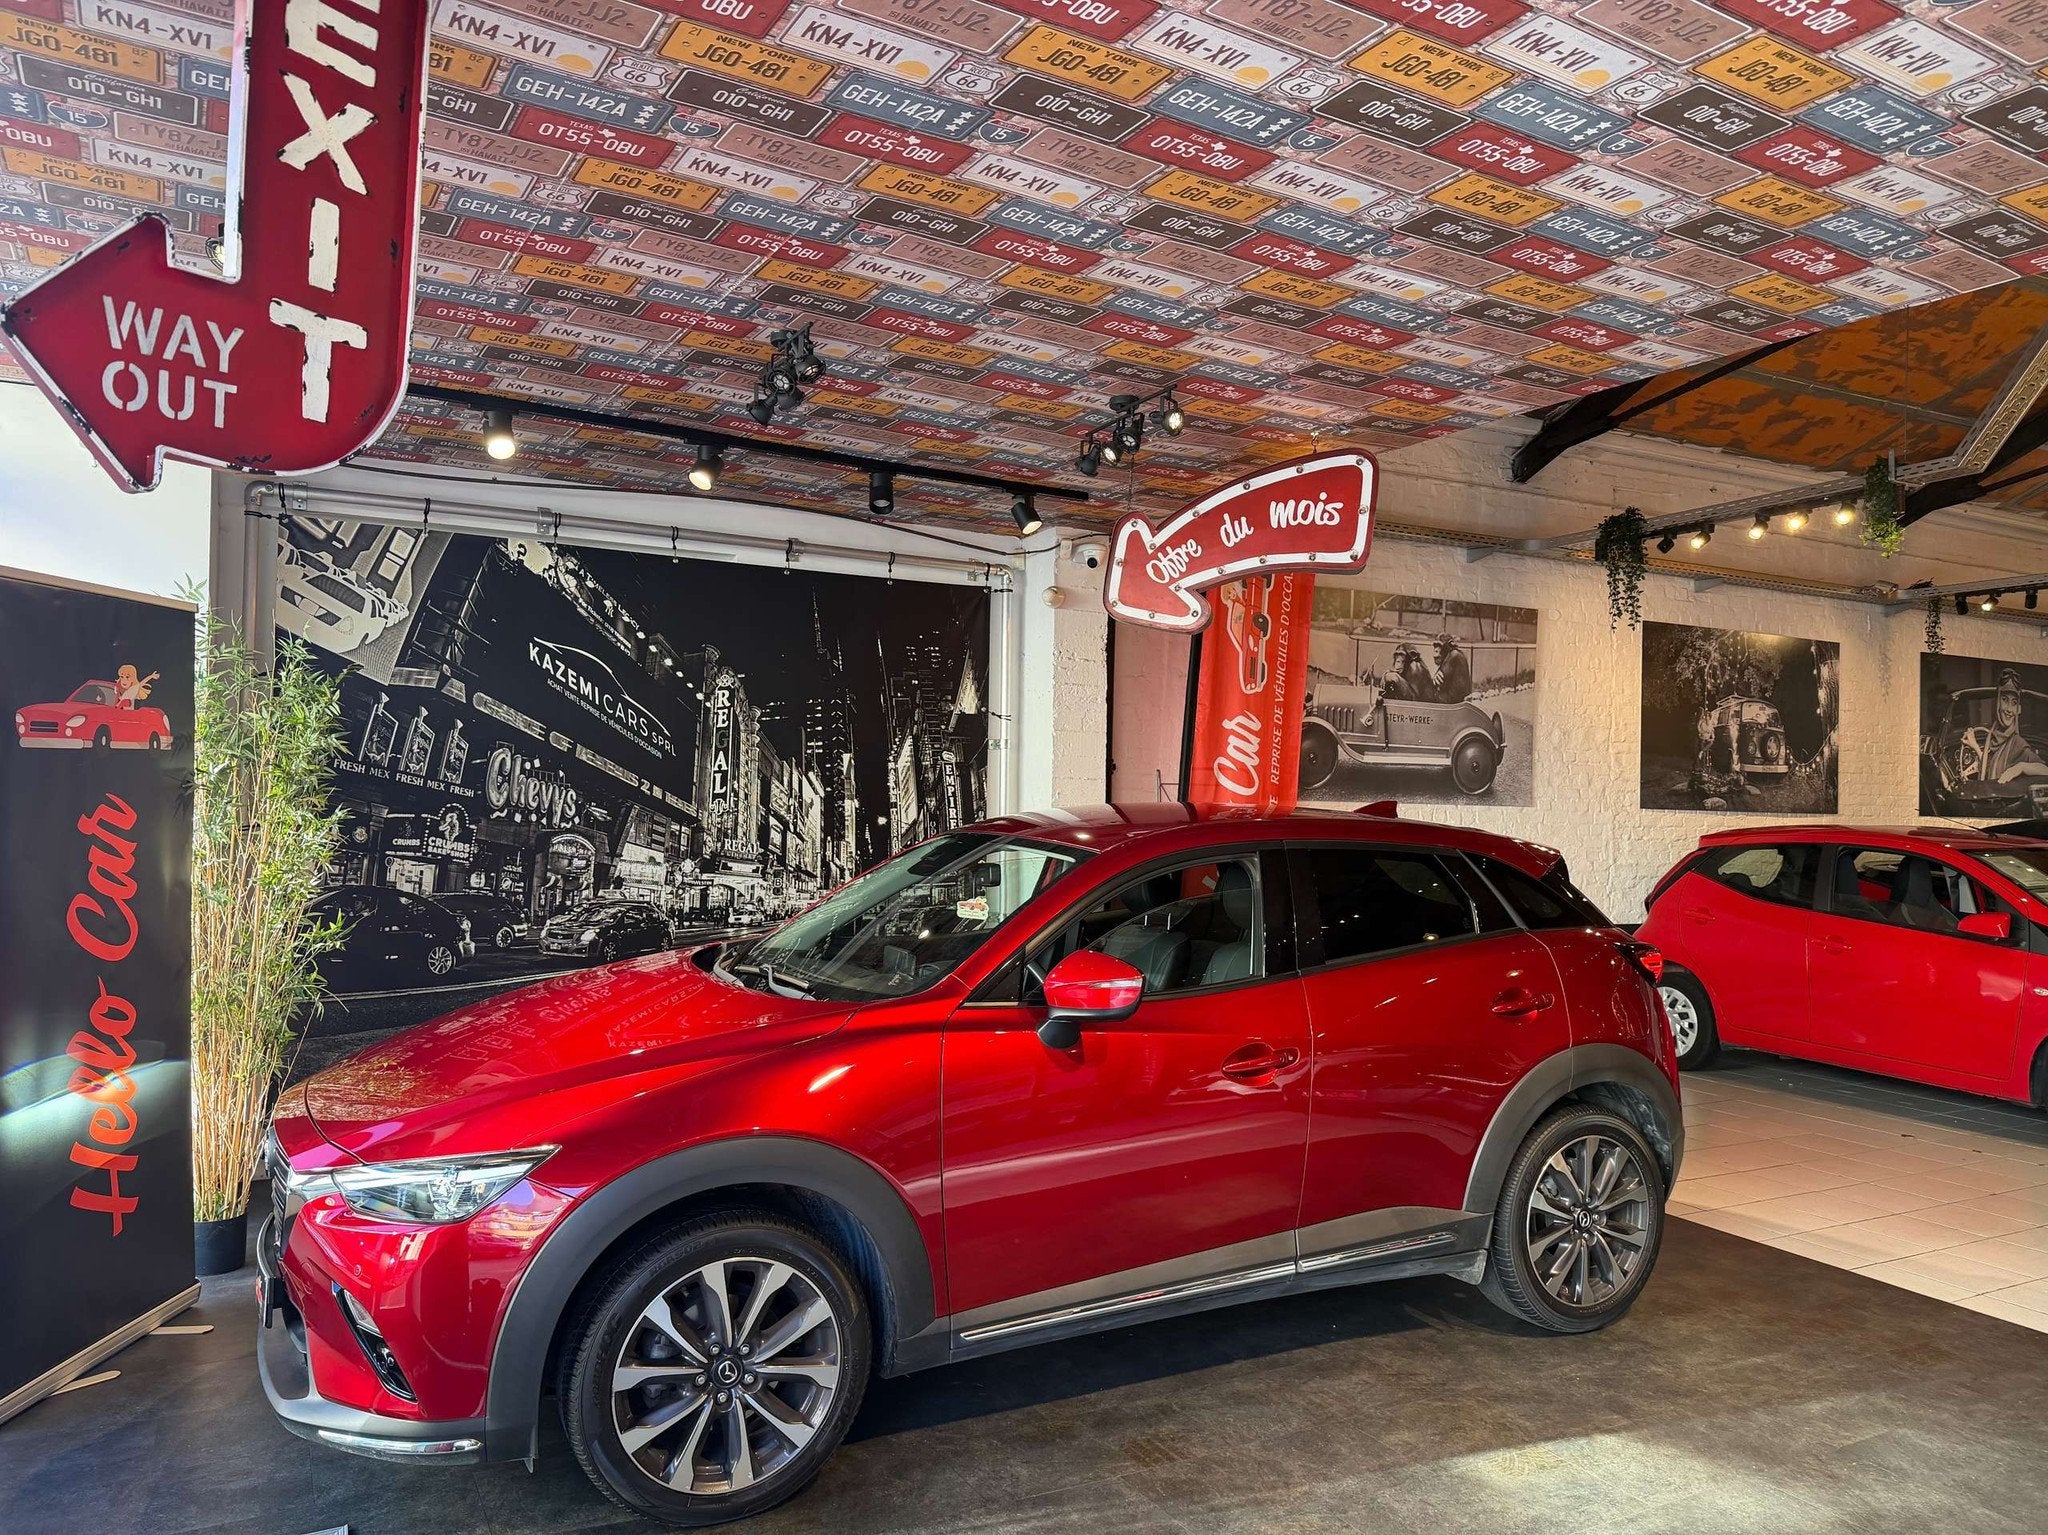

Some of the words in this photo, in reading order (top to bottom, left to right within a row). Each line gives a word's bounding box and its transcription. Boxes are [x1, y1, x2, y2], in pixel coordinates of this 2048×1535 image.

[14, 17, 56, 33] NEW
[66, 29, 114, 47] YORK
[96, 6, 212, 50] KN4-XV1
[447, 13, 557, 57] KN4-XV1
[798, 21, 904, 64] KN4-XV1
[715, 34, 752, 49] NEW
[755, 46, 798, 63] YORK
[1065, 38, 1101, 53] NEW
[1100, 50, 1142, 67] YORK
[1150, 26, 1252, 69] KN4-XV1
[1417, 43, 1452, 59] NEW
[1447, 55, 1487, 72] YORK
[1504, 29, 1602, 73] KN4-XV1
[1770, 48, 1803, 64] NEW
[1795, 60, 1833, 77] YORK
[1858, 34, 1952, 77] KN4-XV1
[622, 68, 648, 83] 66
[953, 74, 982, 89] 66
[1286, 80, 1317, 95] 66
[1620, 83, 1653, 98] 66
[512, 75, 631, 118] GEH-142A
[837, 82, 950, 124] GEH-142A
[1954, 85, 1990, 100] 66
[68, 111, 87, 124] 15
[1162, 88, 1271, 130] GEH-142A
[1489, 92, 1592, 133] GEH-142A
[1816, 95, 1915, 137] GEH-142A
[681, 121, 703, 134] 15
[987, 127, 1013, 140] 15
[1295, 134, 1323, 147] 15
[1604, 138, 1635, 151] 15
[1913, 140, 1947, 153] 15
[107, 148, 203, 179] KN4-XV1
[686, 158, 774, 188] KN4-XV1
[975, 163, 1061, 193] KN4-XV1
[1266, 170, 1349, 199] KN4-XV1
[1557, 173, 1637, 203] KN4-XV1
[1849, 174, 1927, 204] KN4-XV1
[269, 0, 381, 423] EXIT
[454, 196, 555, 226] GEH-142A
[725, 201, 822, 231] GEH-142A
[996, 207, 1089, 236] GEH-142A
[1268, 212, 1357, 241] GEH-142A
[1540, 215, 1627, 244] GEH-142A
[102, 295, 244, 373] WAY
[102, 361, 237, 429] OUT
[1146, 537, 1202, 584] Offre
[1220, 513, 1254, 548] du
[1270, 491, 1344, 529] mois
[1280, 571, 1294, 624] D'OCCA
[1274, 629, 1289, 702] VÉHICULES
[529, 642, 599, 705] KAZEMI
[603, 694, 649, 737] CARS
[651, 731, 677, 757] SPRL
[1274, 707, 1284, 727] DE
[713, 689, 731, 794] REGAL
[1213, 709, 1262, 796] Car
[1270, 728, 1282, 785] REPRISE
[333, 758, 366, 774] FRESH
[369, 767, 391, 779] MEX
[395, 773, 424, 787] FRESH
[427, 779, 445, 791] MEX
[449, 785, 475, 798] FRESH
[945, 764, 958, 830] EMPIRE
[428, 836, 470, 851] CRUMBS
[66, 793, 139, 962] Car
[65, 976, 139, 1237] Hello
